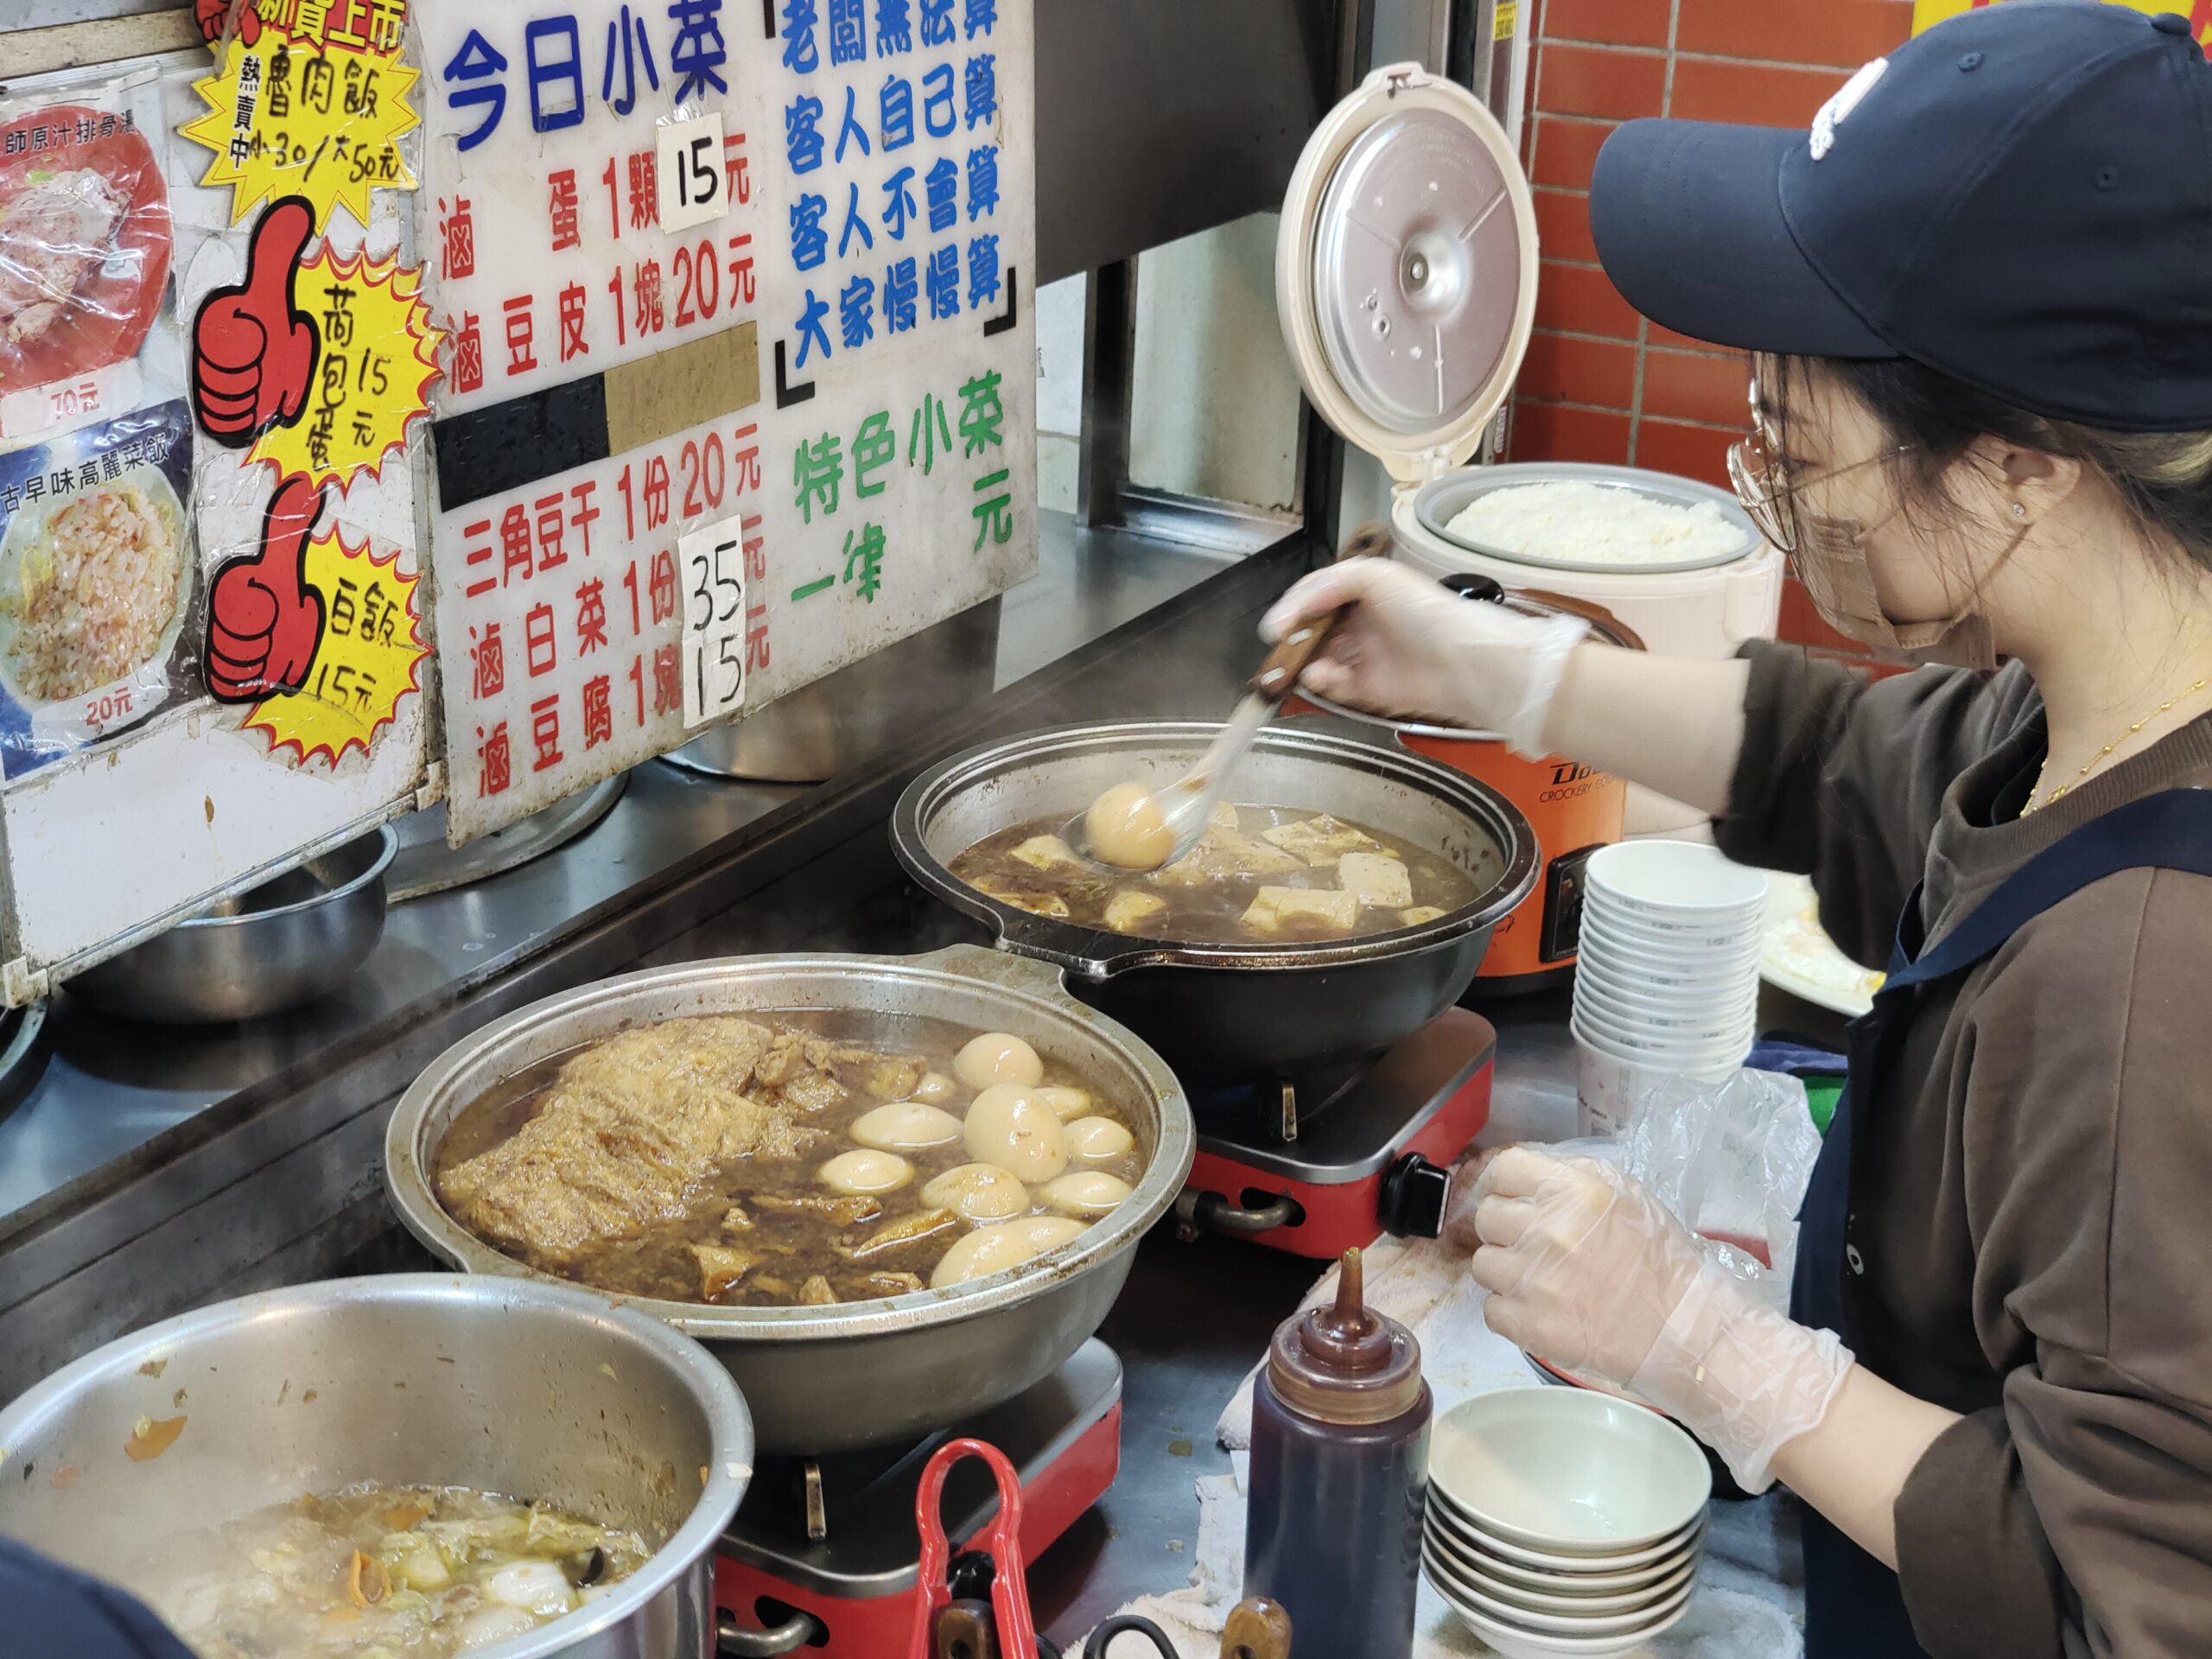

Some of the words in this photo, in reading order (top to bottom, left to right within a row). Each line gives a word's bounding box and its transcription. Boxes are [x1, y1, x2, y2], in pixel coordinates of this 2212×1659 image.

[230, 55, 260, 168] 熱賣中
[265, 44, 379, 118] 魯肉飯
[444, 0, 728, 152] 今日小菜
[785, 54, 998, 175] 客人自己算
[790, 145, 1000, 272] 客人不會算
[795, 234, 1001, 369] 大家慢慢算
[51, 382, 100, 420] 70元
[793, 369, 1003, 524] 特色小菜
[0, 433, 169, 514] 古早味高麗菜飯
[791, 522, 886, 603] 一律
[86, 686, 133, 726] 20元
[316, 663, 377, 713] 15元
